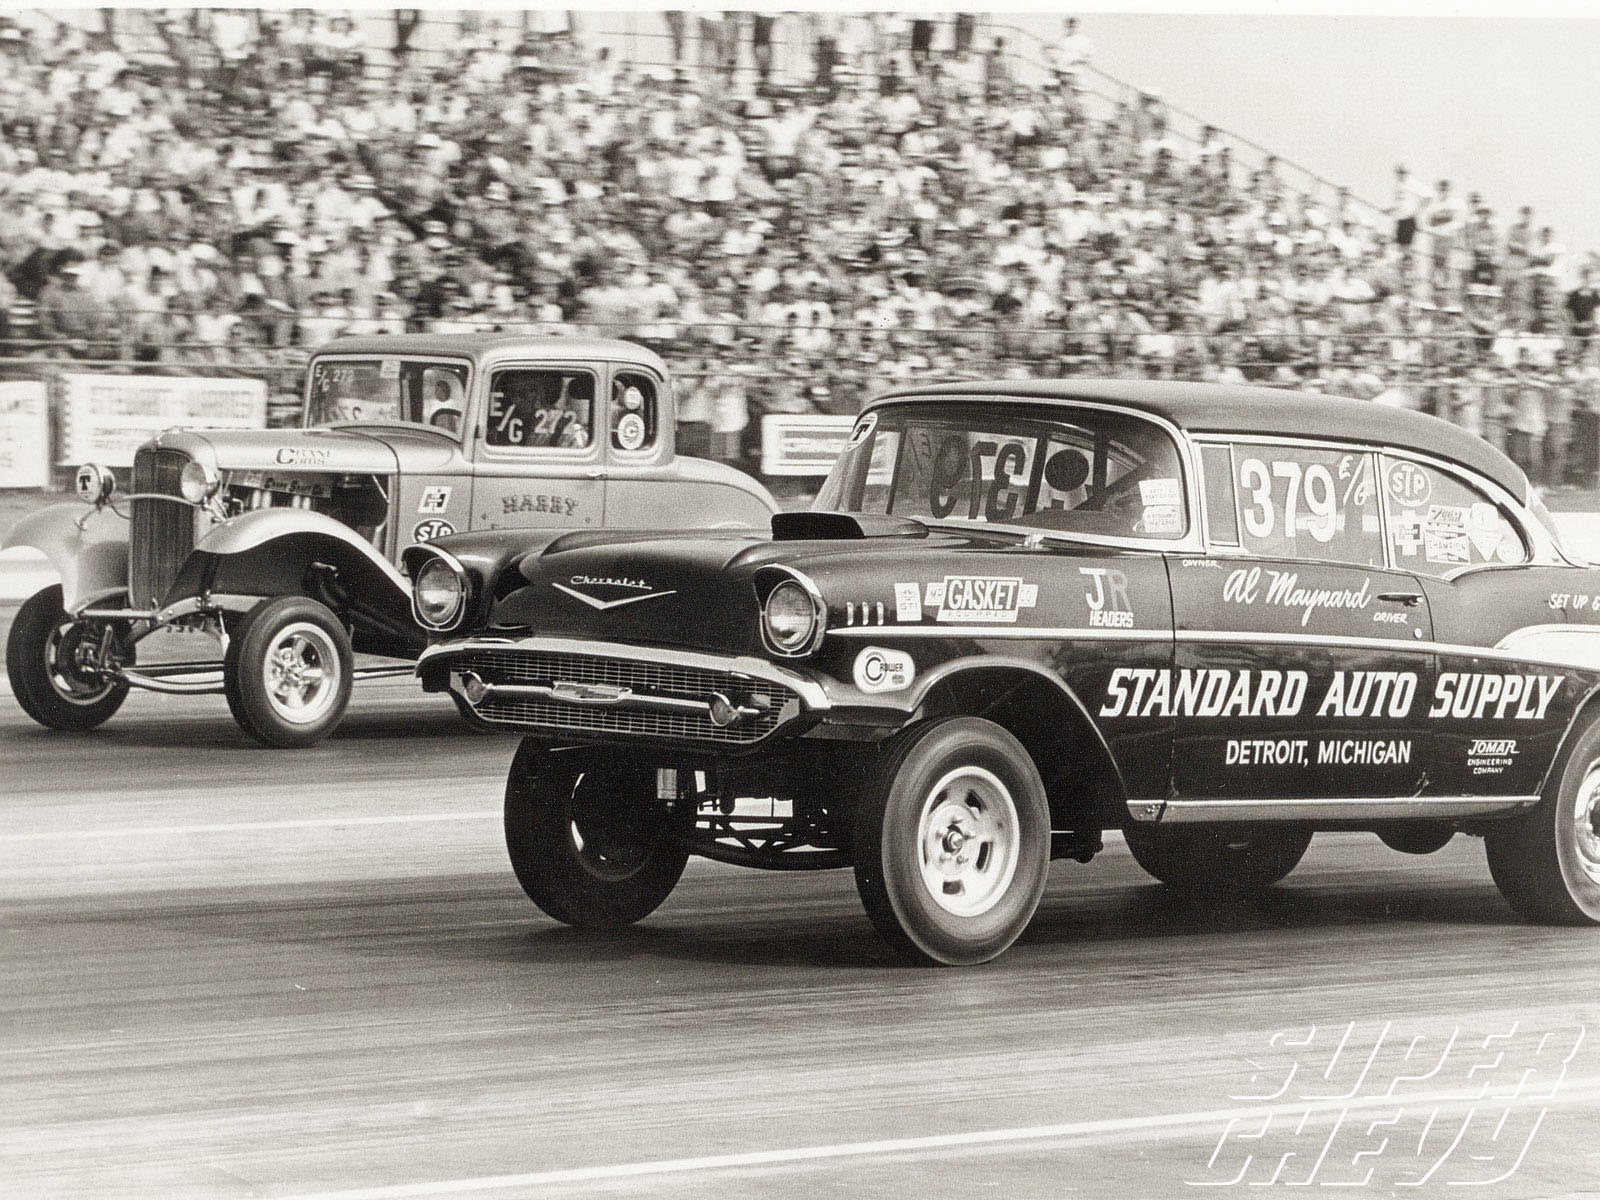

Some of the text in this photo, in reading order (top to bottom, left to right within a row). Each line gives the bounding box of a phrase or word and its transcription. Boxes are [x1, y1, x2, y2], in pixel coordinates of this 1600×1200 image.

[1392, 465, 1425, 497] STP
[502, 494, 579, 516] HARRY
[1241, 458, 1337, 542] 379
[1183, 559, 1223, 570] OWNER
[570, 575, 653, 591] Chevrolet
[1078, 566, 1132, 611] JR
[948, 579, 1018, 610] GASKET
[1264, 570, 1371, 627] Maynard
[1548, 592, 1571, 609] SET
[1573, 594, 1589, 609] UP
[1089, 610, 1134, 628] HEADERS
[1373, 611, 1408, 624] DRIVER
[1100, 667, 1566, 720] STANDARD AUTO SUPPLY
[1225, 740, 1411, 768] DETROIT, MICHIGAN
[1467, 739, 1520, 756] JOMAR
[1467, 758, 1513, 766] ENGINEERING
[1473, 766, 1504, 775] COMPANY
